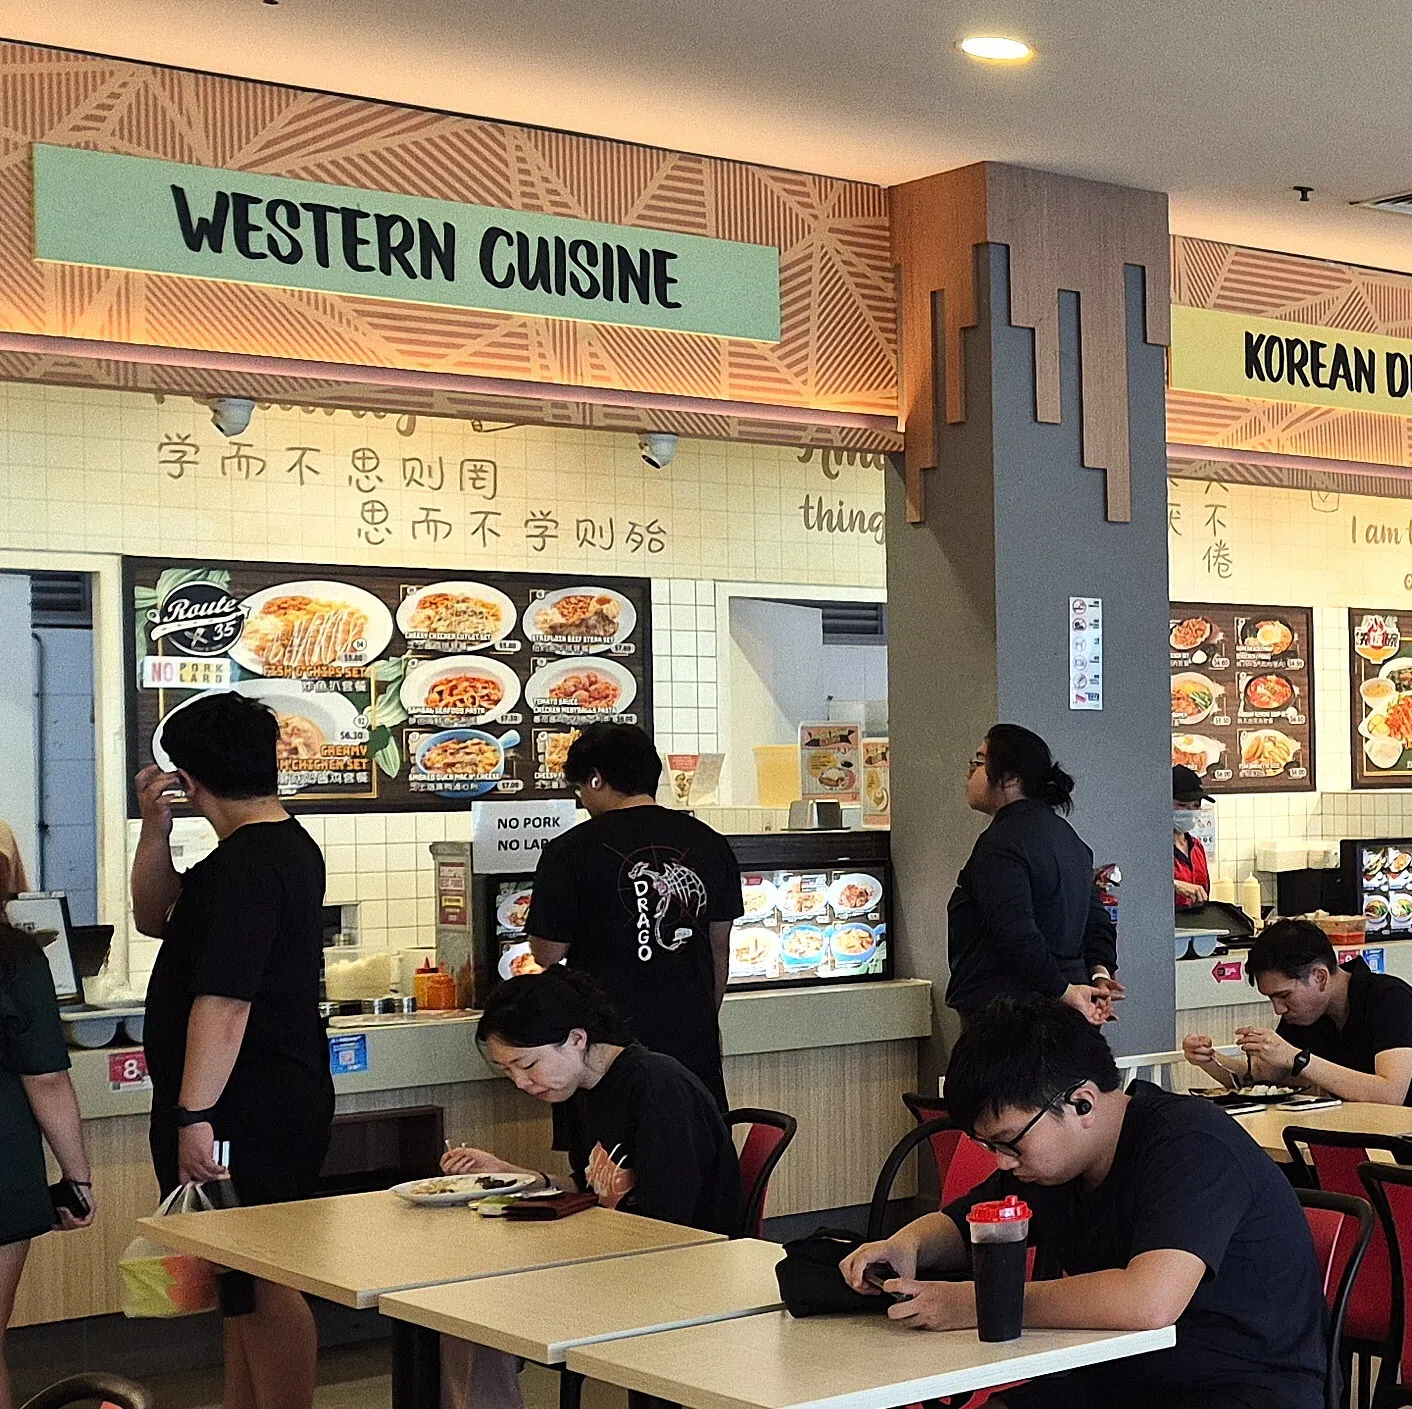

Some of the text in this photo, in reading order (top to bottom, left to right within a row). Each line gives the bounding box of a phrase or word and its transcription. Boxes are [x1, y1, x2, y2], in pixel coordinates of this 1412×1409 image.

[171, 184, 682, 309] WESTERN CUISINE
[1244, 330, 1376, 394] KOREAN
[158, 432, 498, 500] 学而不思则罔
[357, 499, 668, 554] 思而不学则殆
[1350, 515, 1358, 545] I
[1365, 523, 1403, 545] am
[163, 595, 238, 622] Route
[212, 620, 238, 641] 35
[151, 661, 225, 682] NO PORK
[179, 673, 224, 683] LARD
[263, 664, 293, 678] FISH
[344, 667, 367, 678] SET
[320, 745, 368, 757] CREAMY
[346, 759, 369, 770] SET
[497, 817, 561, 829] NO PORK
[497, 838, 551, 851] NO LAR
[634, 880, 653, 962] DRAGO
